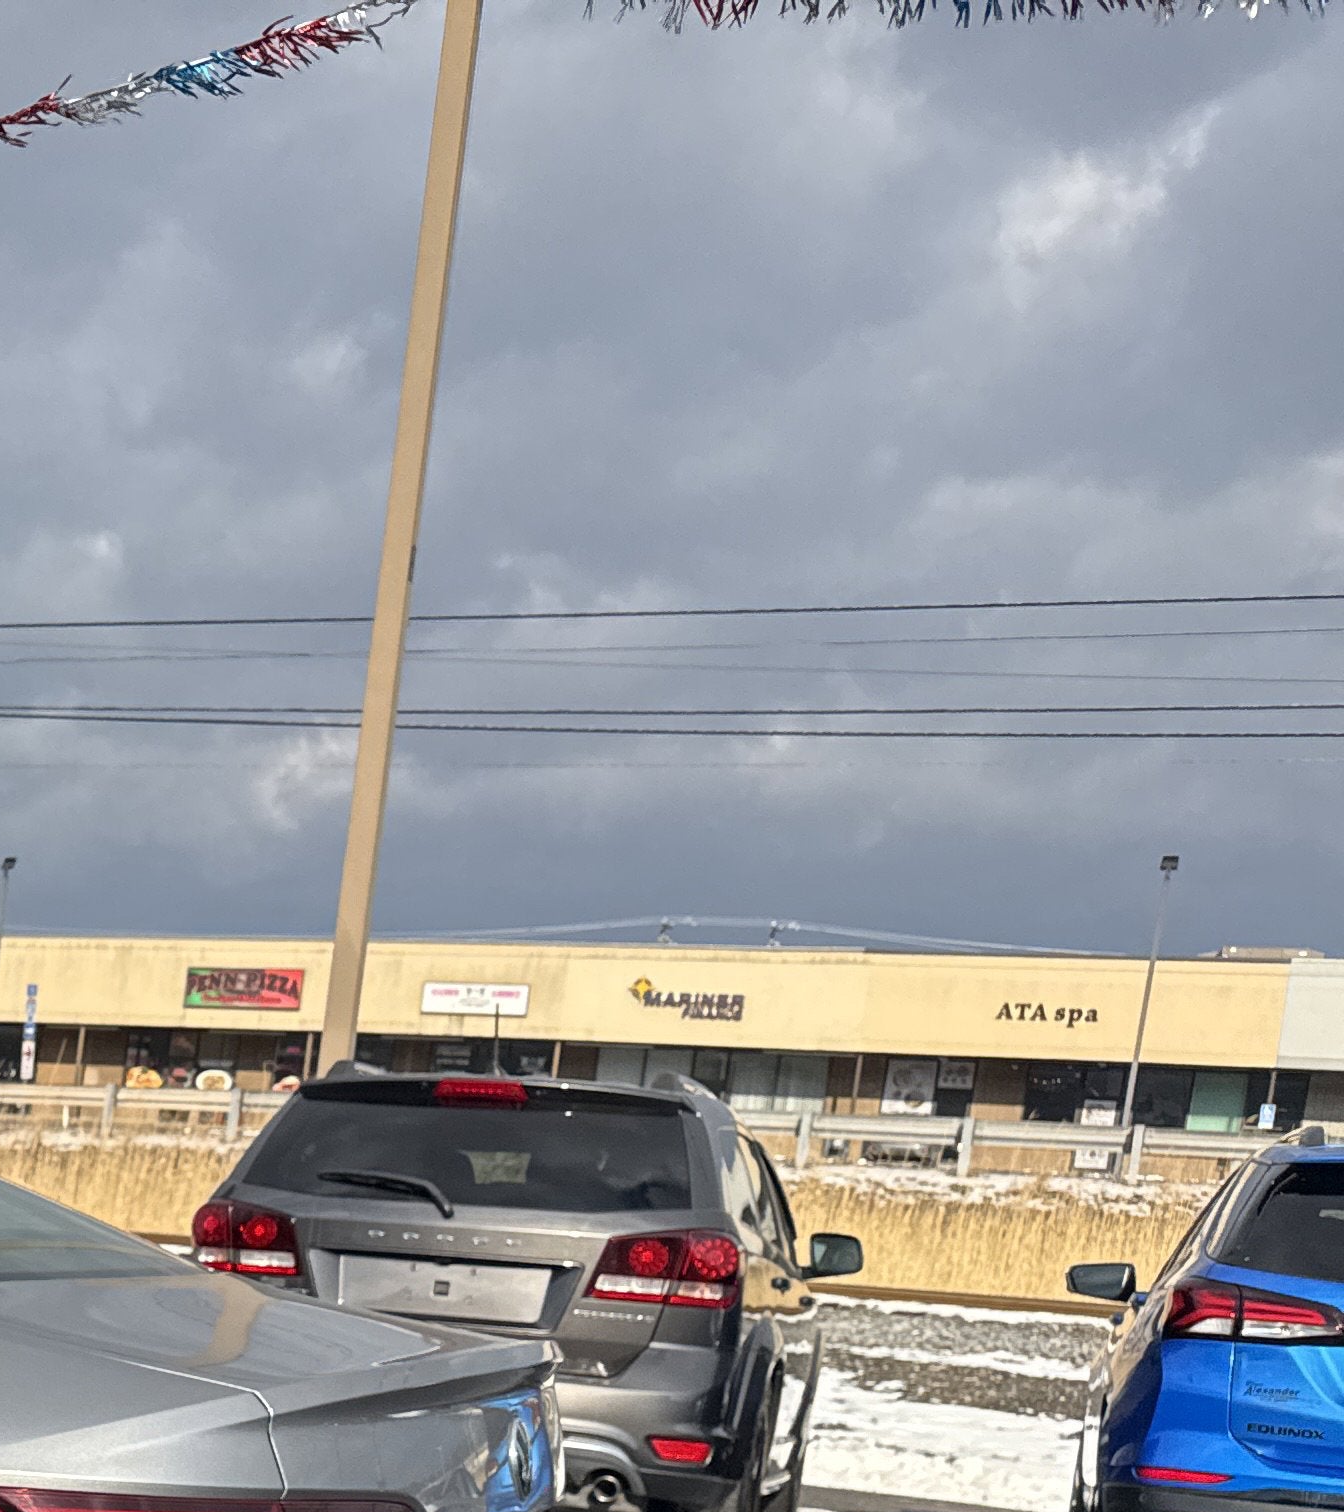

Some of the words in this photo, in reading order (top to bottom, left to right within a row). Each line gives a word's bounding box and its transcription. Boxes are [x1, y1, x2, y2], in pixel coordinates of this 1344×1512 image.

[186, 972, 237, 995] PENN
[244, 971, 299, 999] PIZZA
[643, 991, 745, 1008] MARINER
[995, 1002, 1047, 1021] ATA
[1054, 1007, 1098, 1028] spa
[1242, 1384, 1300, 1397] Alexander
[1246, 1423, 1326, 1440] EQUINOX
